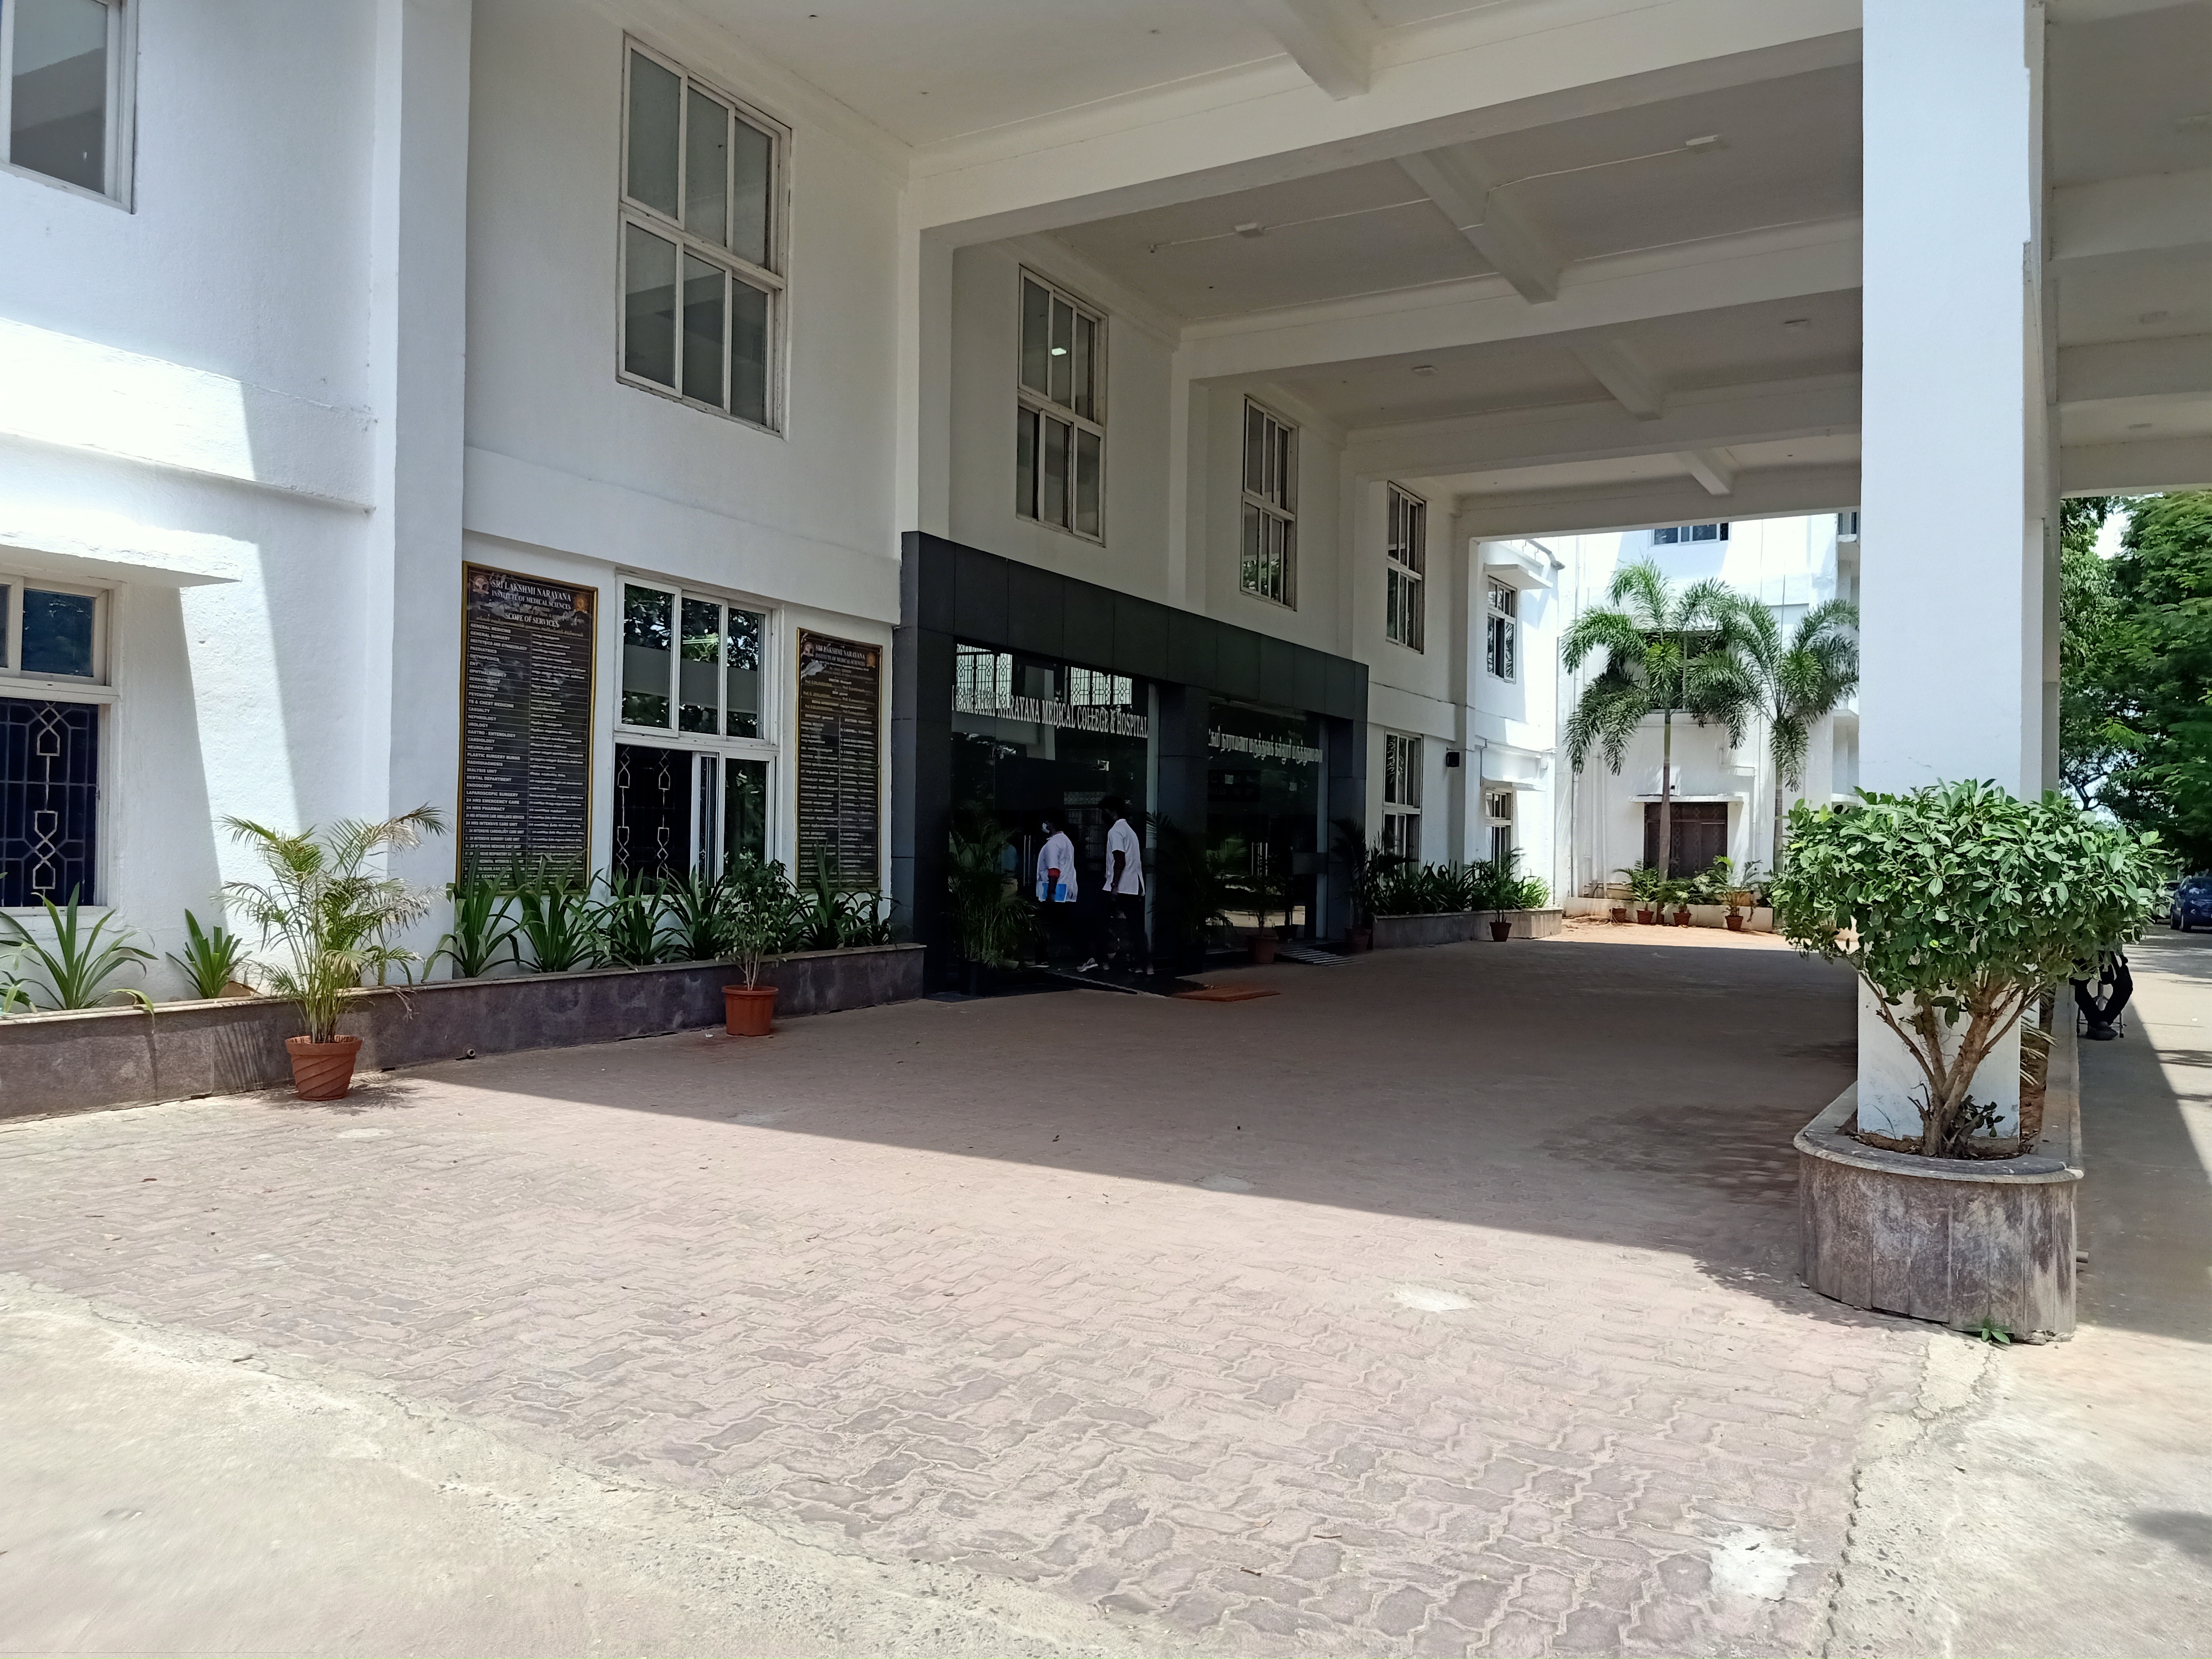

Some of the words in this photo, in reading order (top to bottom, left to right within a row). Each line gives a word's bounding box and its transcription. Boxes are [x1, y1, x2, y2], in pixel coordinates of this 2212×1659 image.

[492, 580, 503, 589] SRI
[504, 581, 535, 595] LAKSHMI
[537, 588, 571, 602] NARAYANA
[492, 589, 518, 601] INSTITUTE
[526, 596, 549, 606] MEDICAL
[549, 600, 571, 610] SCIENCES
[505, 613, 524, 622] SCOPE
[533, 617, 559, 628] SERVICES
[997, 692, 1041, 723] NARAYANA
[1042, 700, 1076, 728] MEDICAL
[1077, 706, 1109, 733] COLLEGE
[1110, 708, 1116, 734] &
[1116, 712, 1149, 739] HOSPITAL
